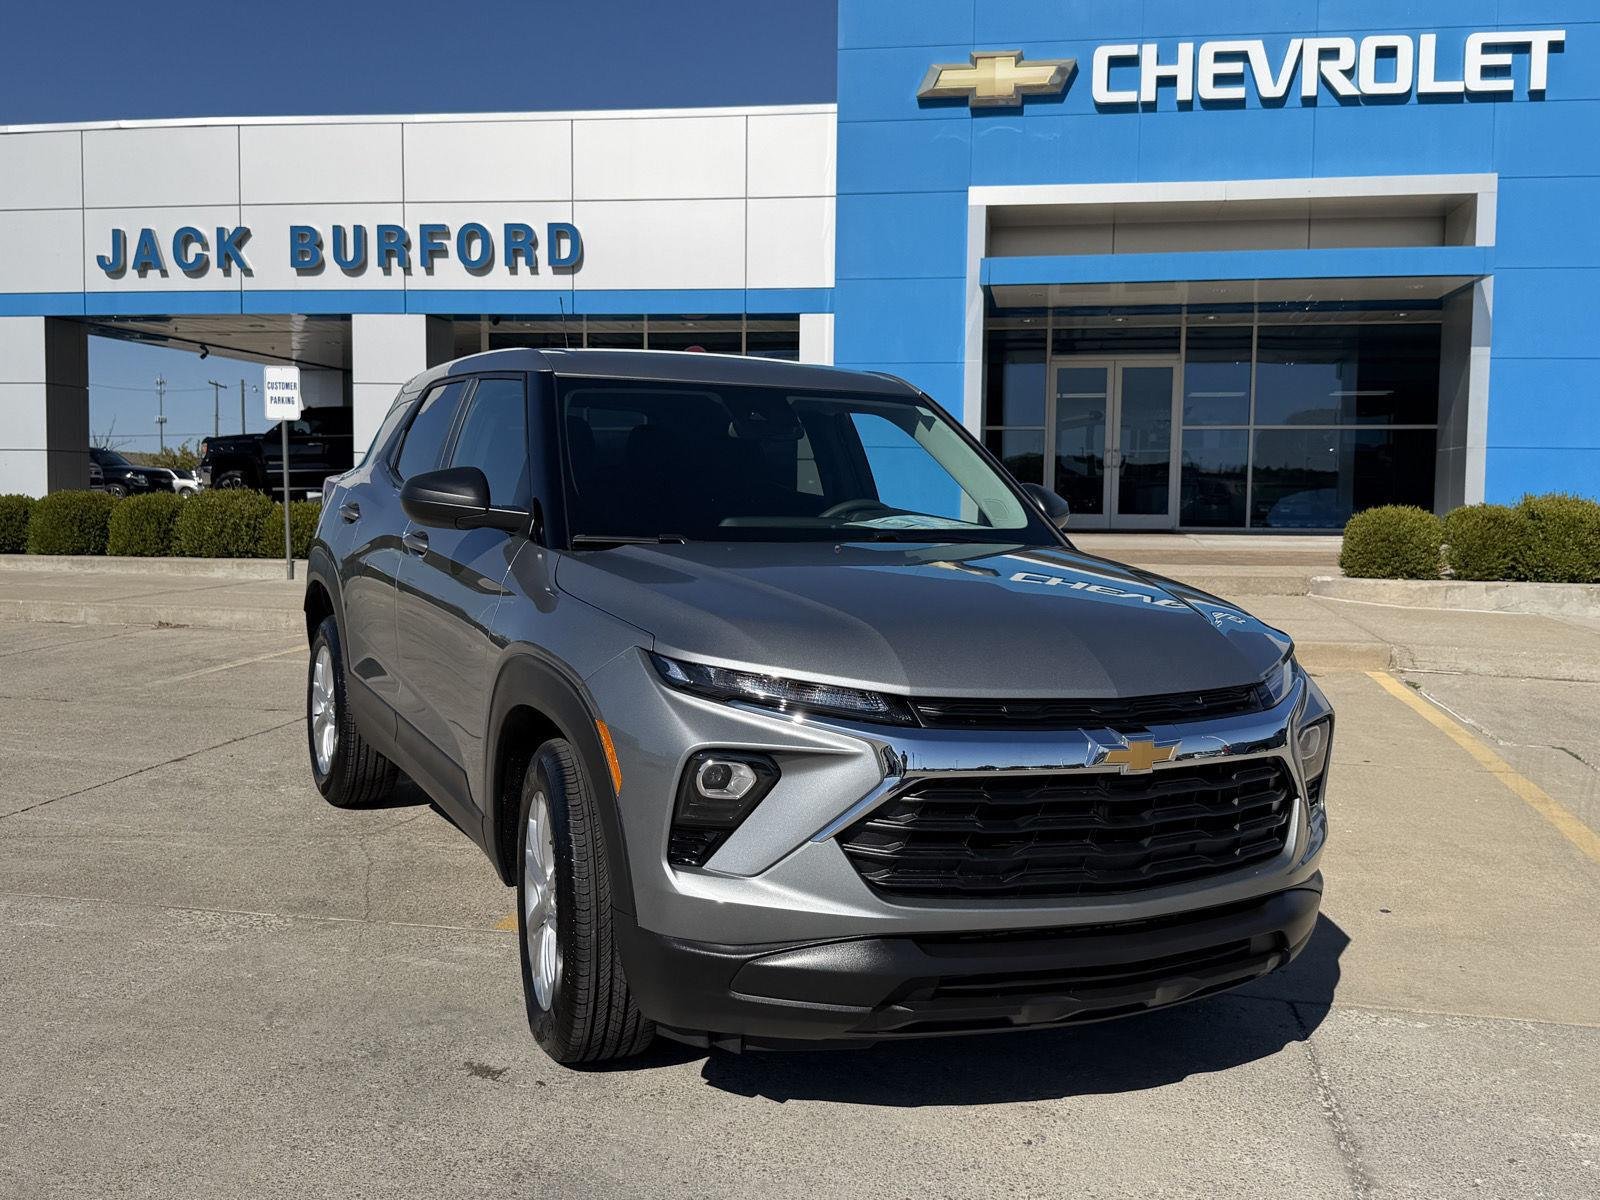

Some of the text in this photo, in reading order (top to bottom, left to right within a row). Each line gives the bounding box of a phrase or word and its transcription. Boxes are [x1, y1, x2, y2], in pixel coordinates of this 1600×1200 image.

[1092, 30, 1566, 104] CHEVROLET
[96, 222, 584, 279] JACK BURFORD
[267, 381, 297, 391] CUSTOMER
[270, 396, 295, 405] PARKING
